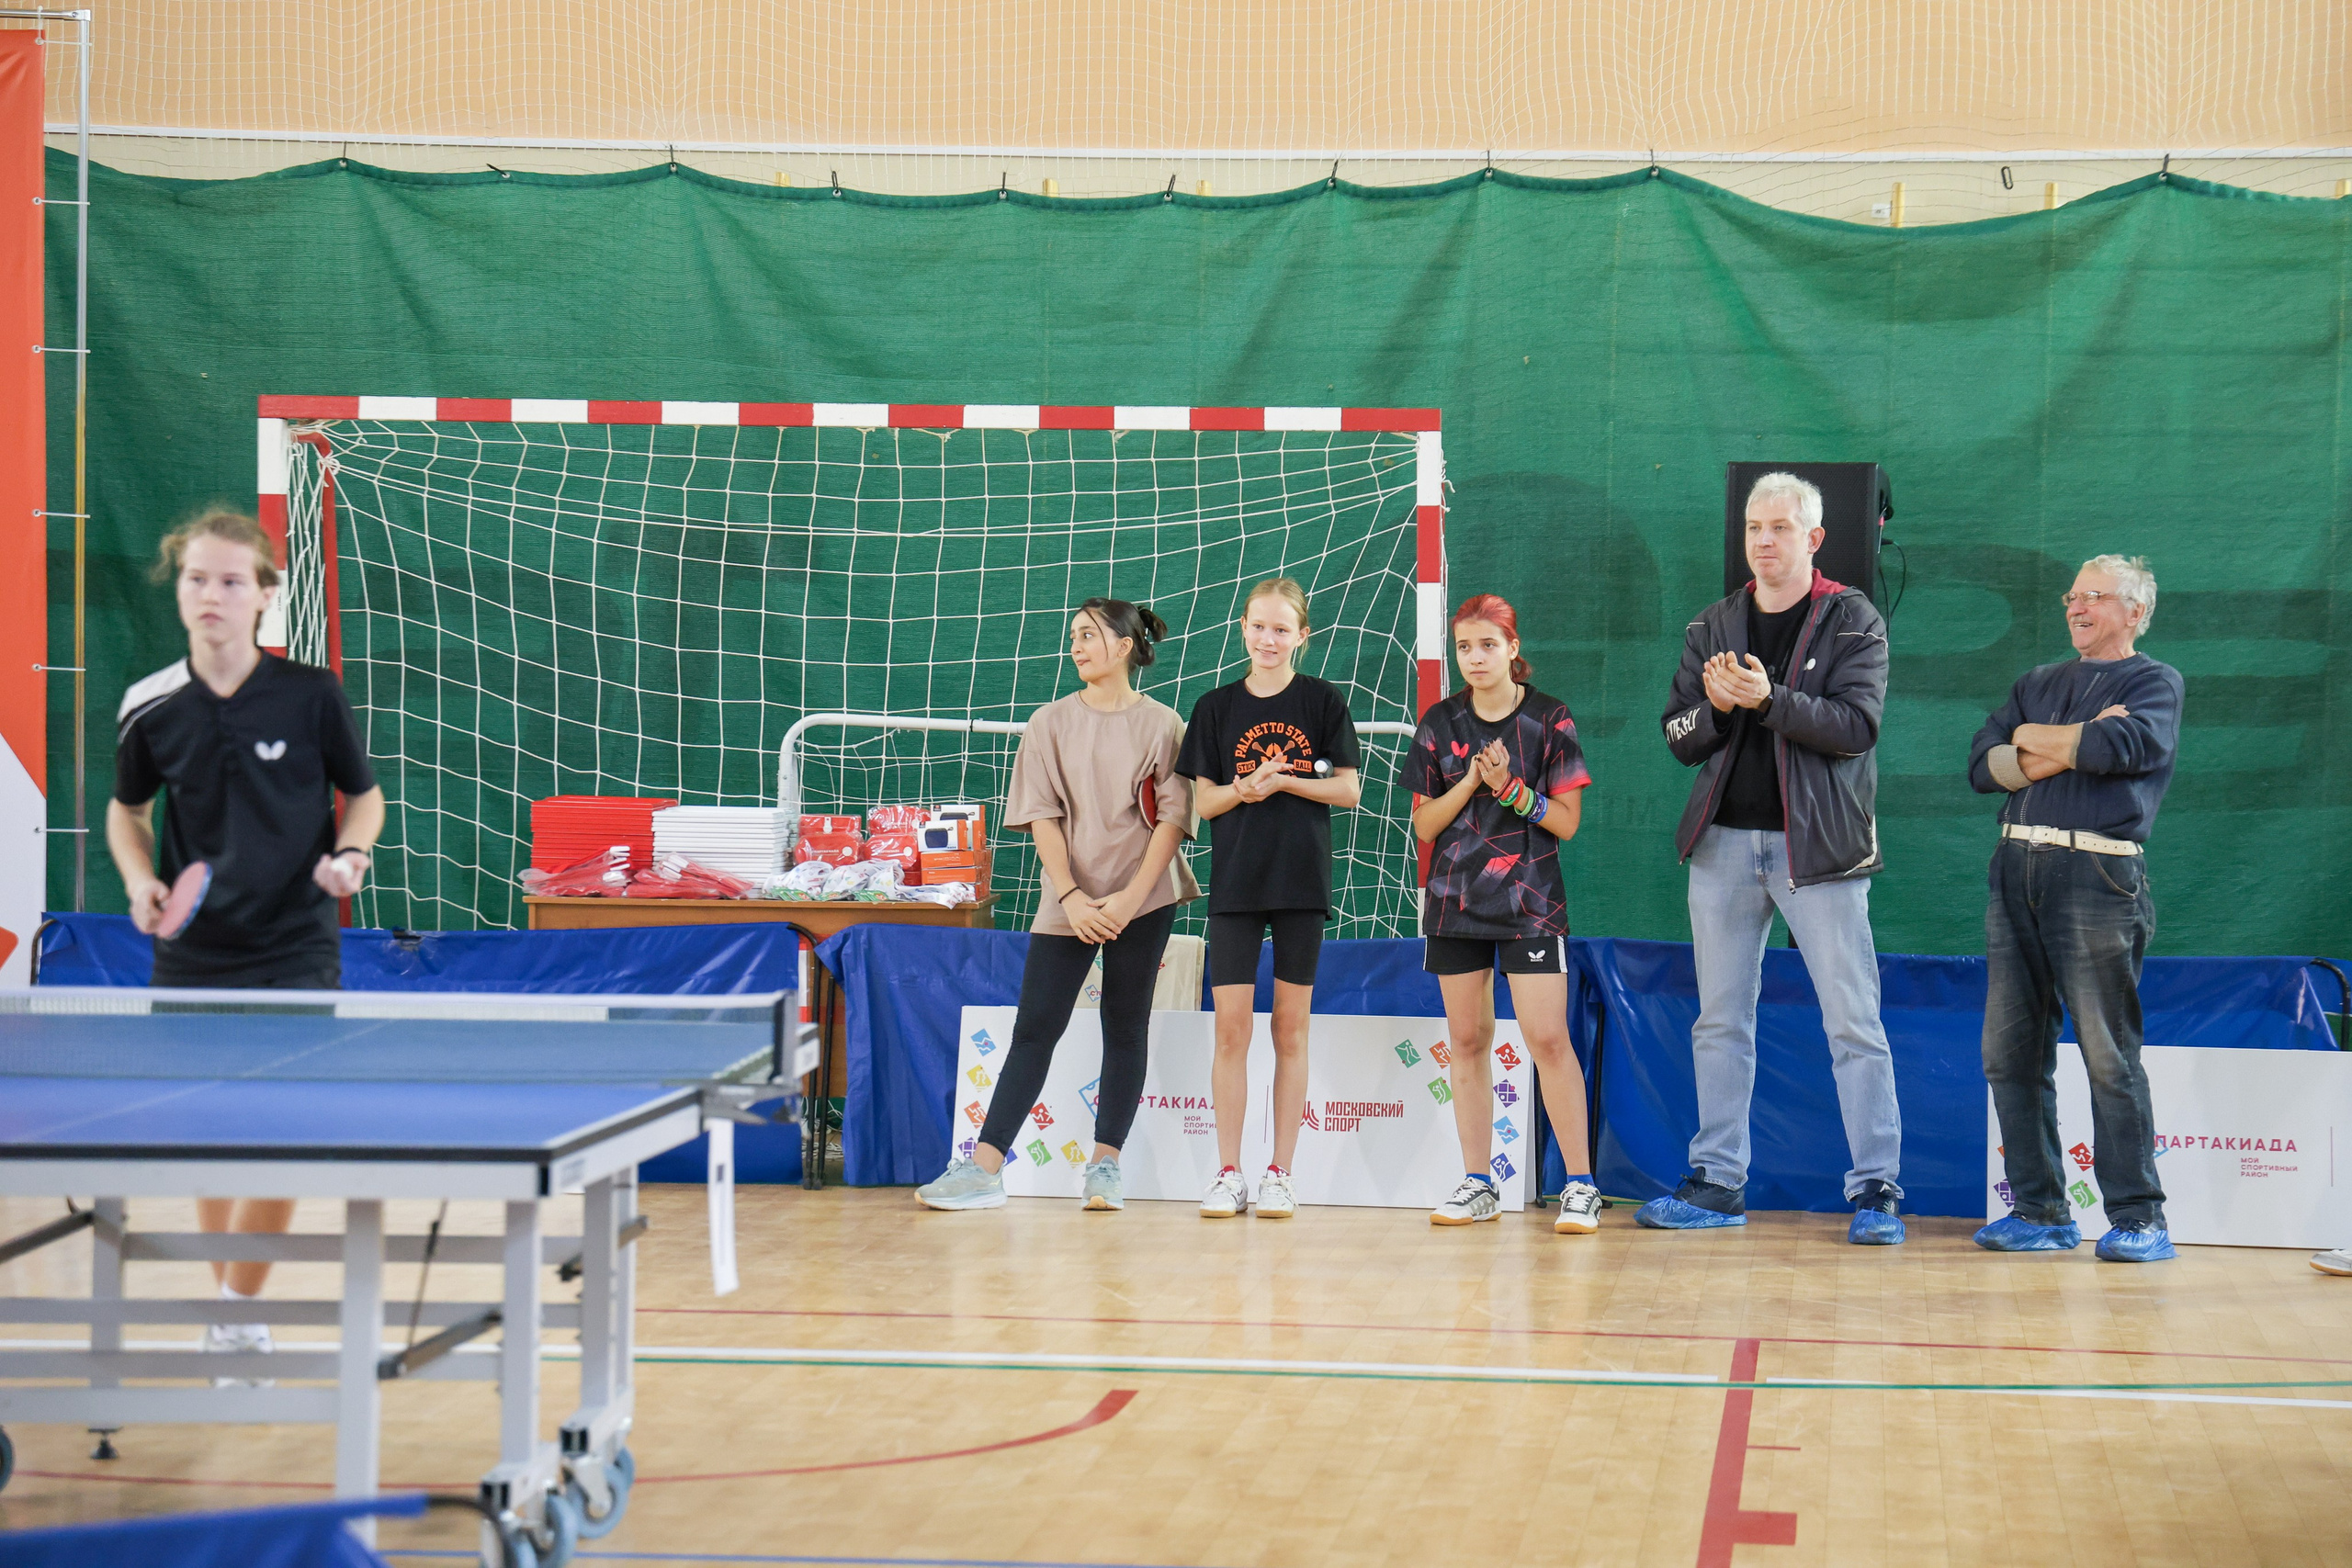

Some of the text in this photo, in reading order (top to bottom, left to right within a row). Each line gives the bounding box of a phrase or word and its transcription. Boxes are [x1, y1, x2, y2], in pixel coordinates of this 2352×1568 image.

[1235, 722, 1312, 758] PALMETTO STATE
[1295, 761, 1311, 771] BALL
[1325, 1100, 1404, 1118] МОСКОВСКИЙ
[1324, 1117, 1362, 1132] СПОРТ
[2154, 1134, 2297, 1152] ПАРТАКИАДА
[2241, 1164, 2298, 1172] СПОРТИВНЫЙ
